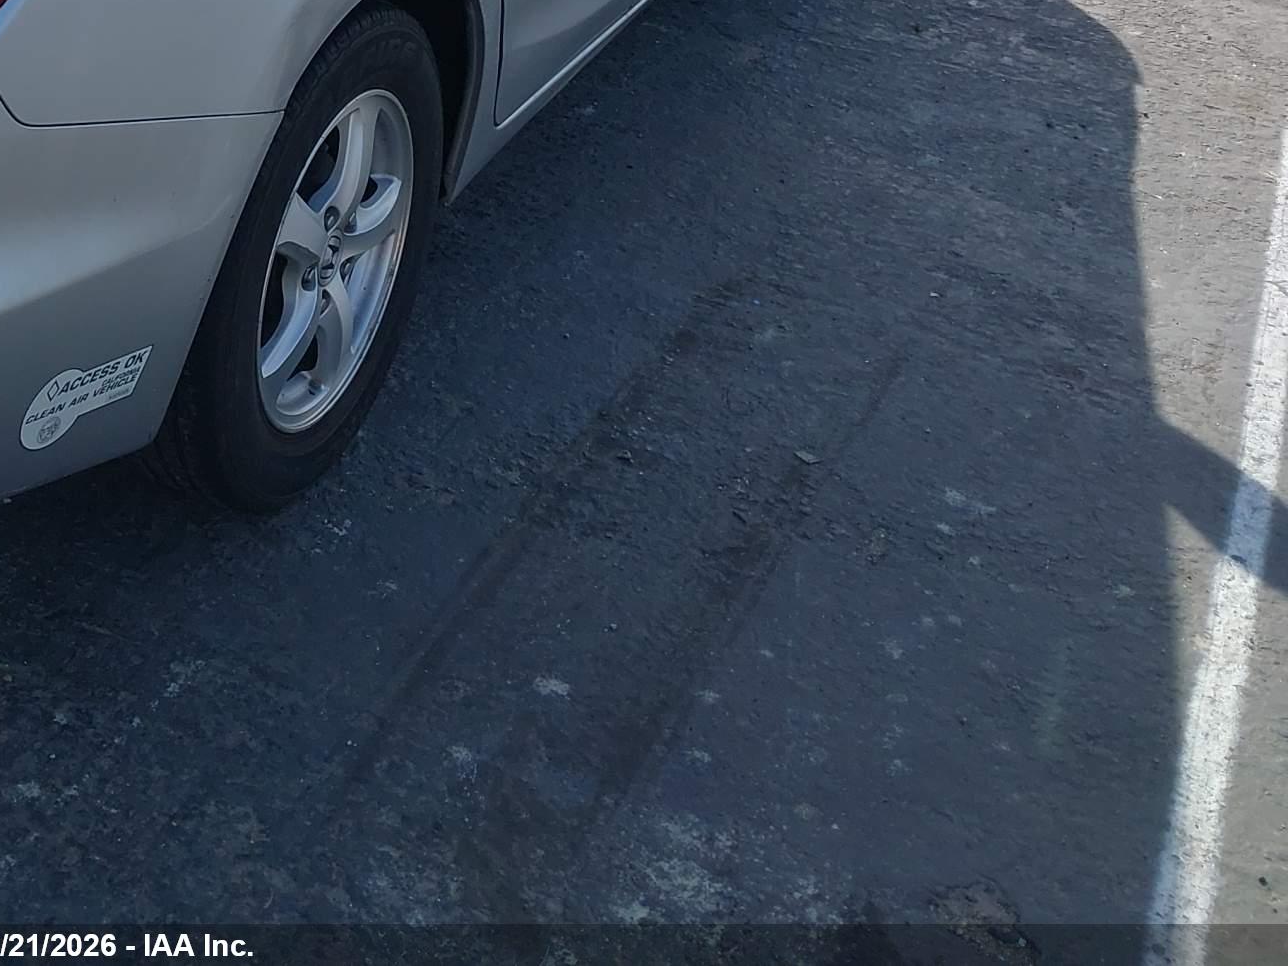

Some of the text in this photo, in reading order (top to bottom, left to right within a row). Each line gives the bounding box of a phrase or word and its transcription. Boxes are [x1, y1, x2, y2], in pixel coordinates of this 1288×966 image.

[58, 361, 121, 396] ACCESS
[124, 350, 149, 369] OK
[25, 401, 68, 425] CLEAN
[68, 392, 90, 408] AIR
[93, 373, 138, 397] VEHICLE
